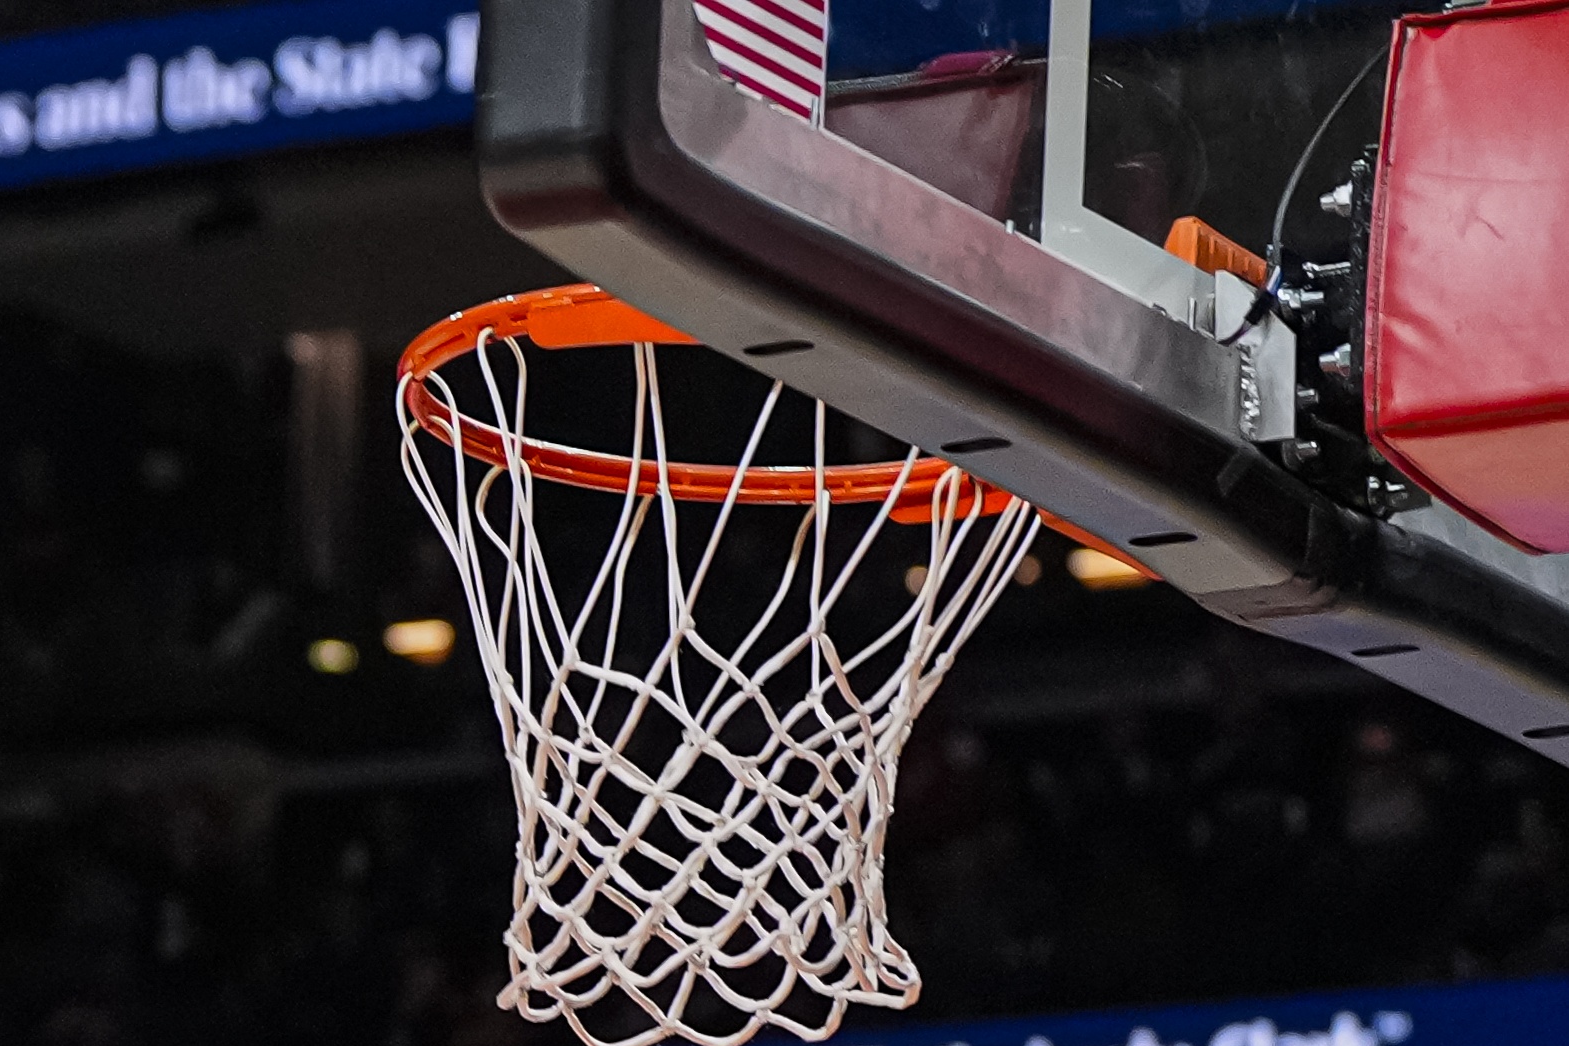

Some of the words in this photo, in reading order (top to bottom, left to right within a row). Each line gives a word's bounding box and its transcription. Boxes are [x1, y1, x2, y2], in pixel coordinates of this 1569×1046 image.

[34, 54, 158, 149] and
[162, 46, 270, 131] the
[273, 27, 442, 115] State
